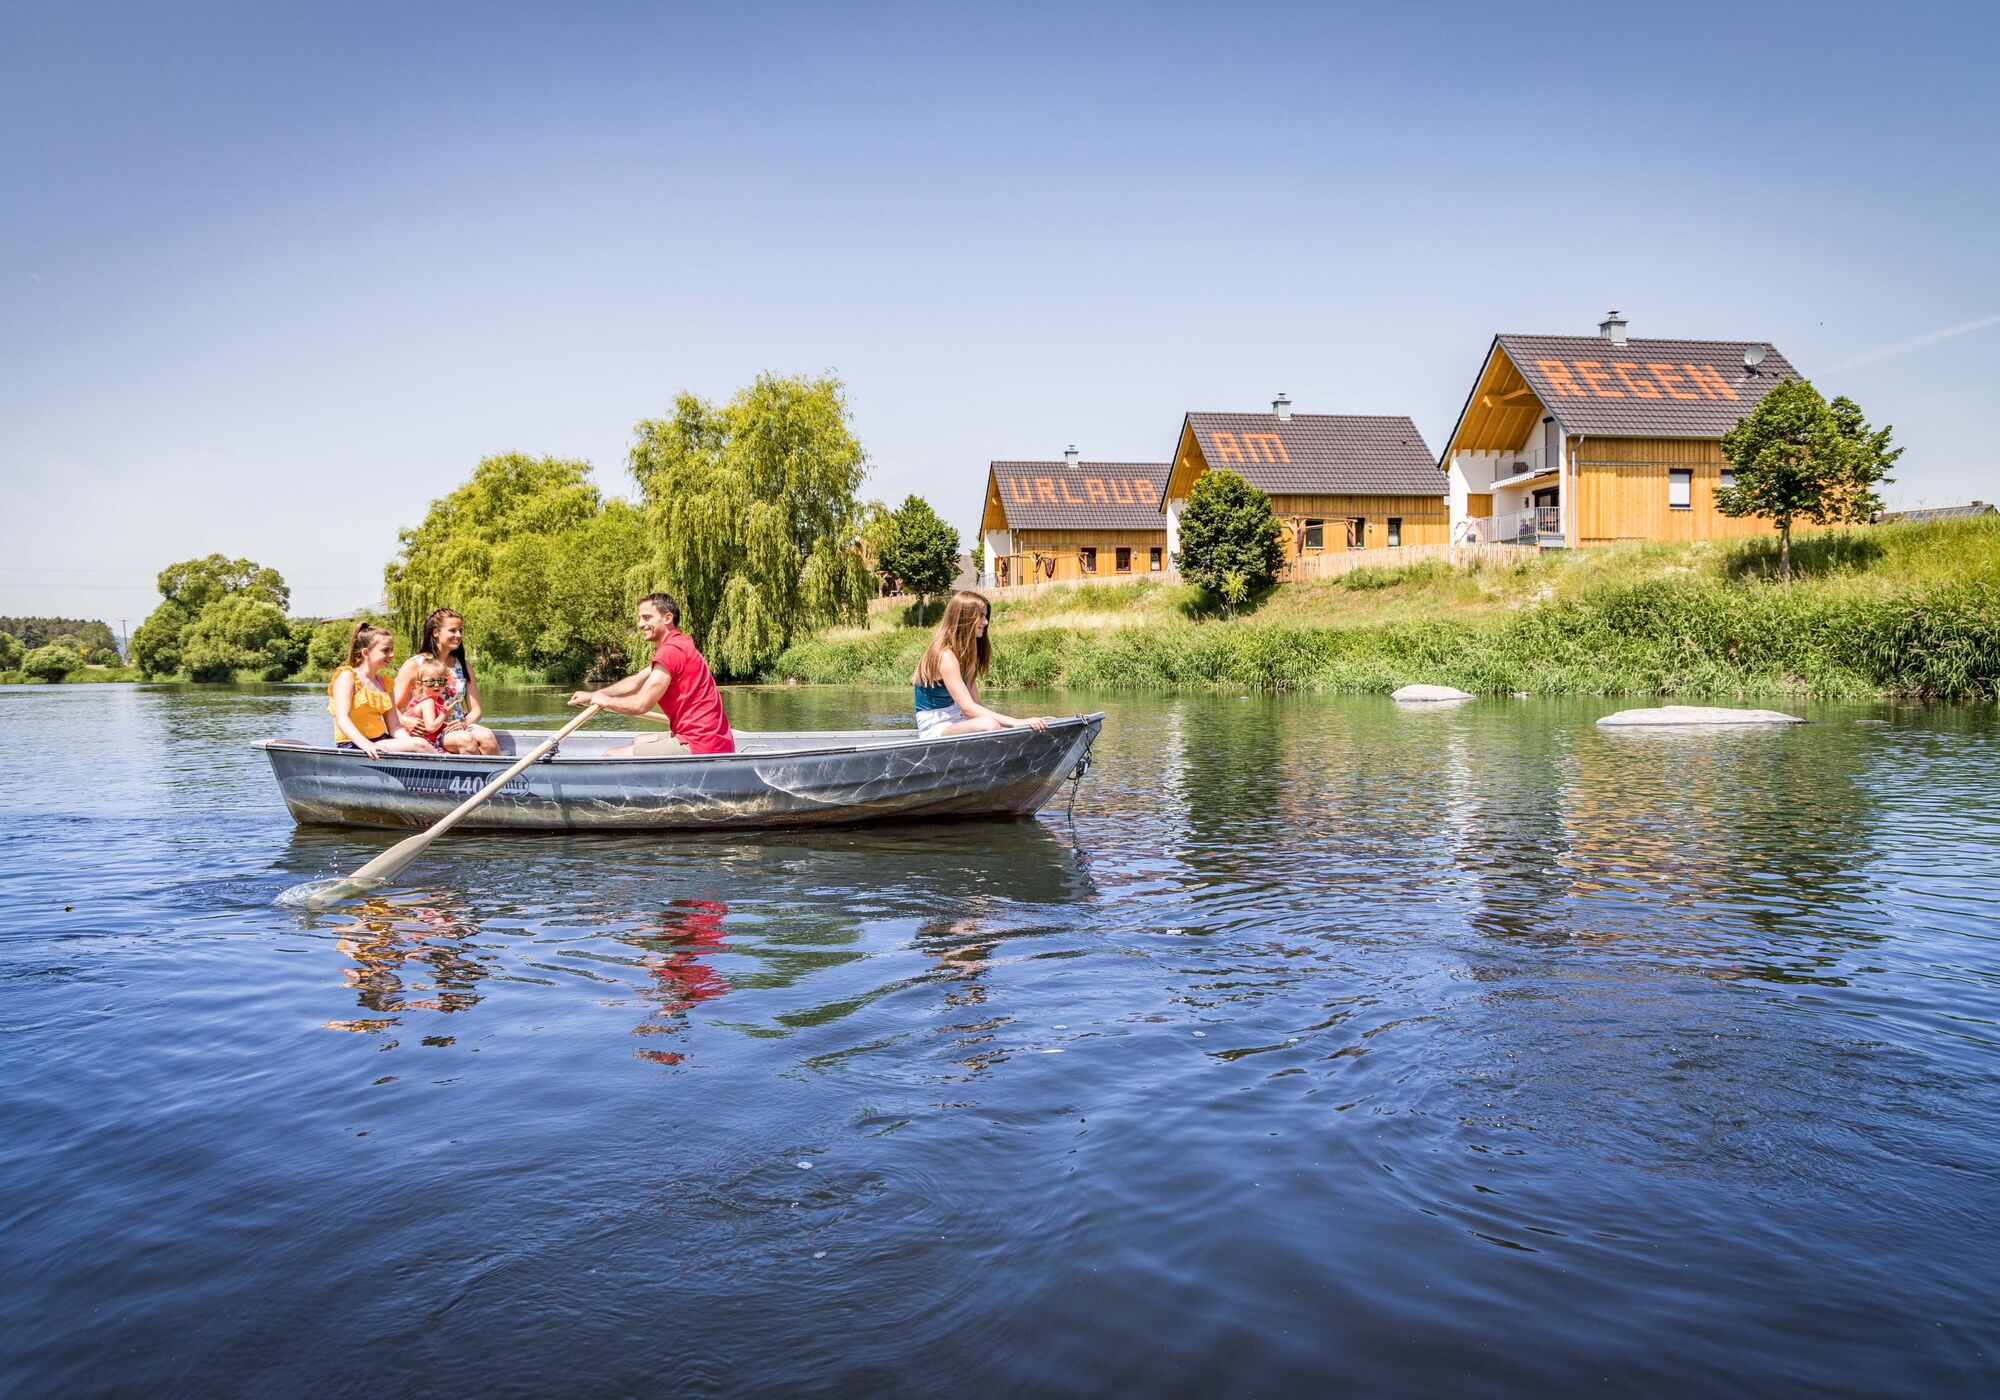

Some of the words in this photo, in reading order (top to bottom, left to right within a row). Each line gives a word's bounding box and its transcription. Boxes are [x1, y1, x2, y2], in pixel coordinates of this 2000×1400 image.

[1536, 359, 1739, 401] REGEN
[1211, 431, 1291, 464] AM
[1009, 476, 1159, 504] URLAUB
[407, 786, 446, 794] FISHING
[449, 775, 484, 796] 440
